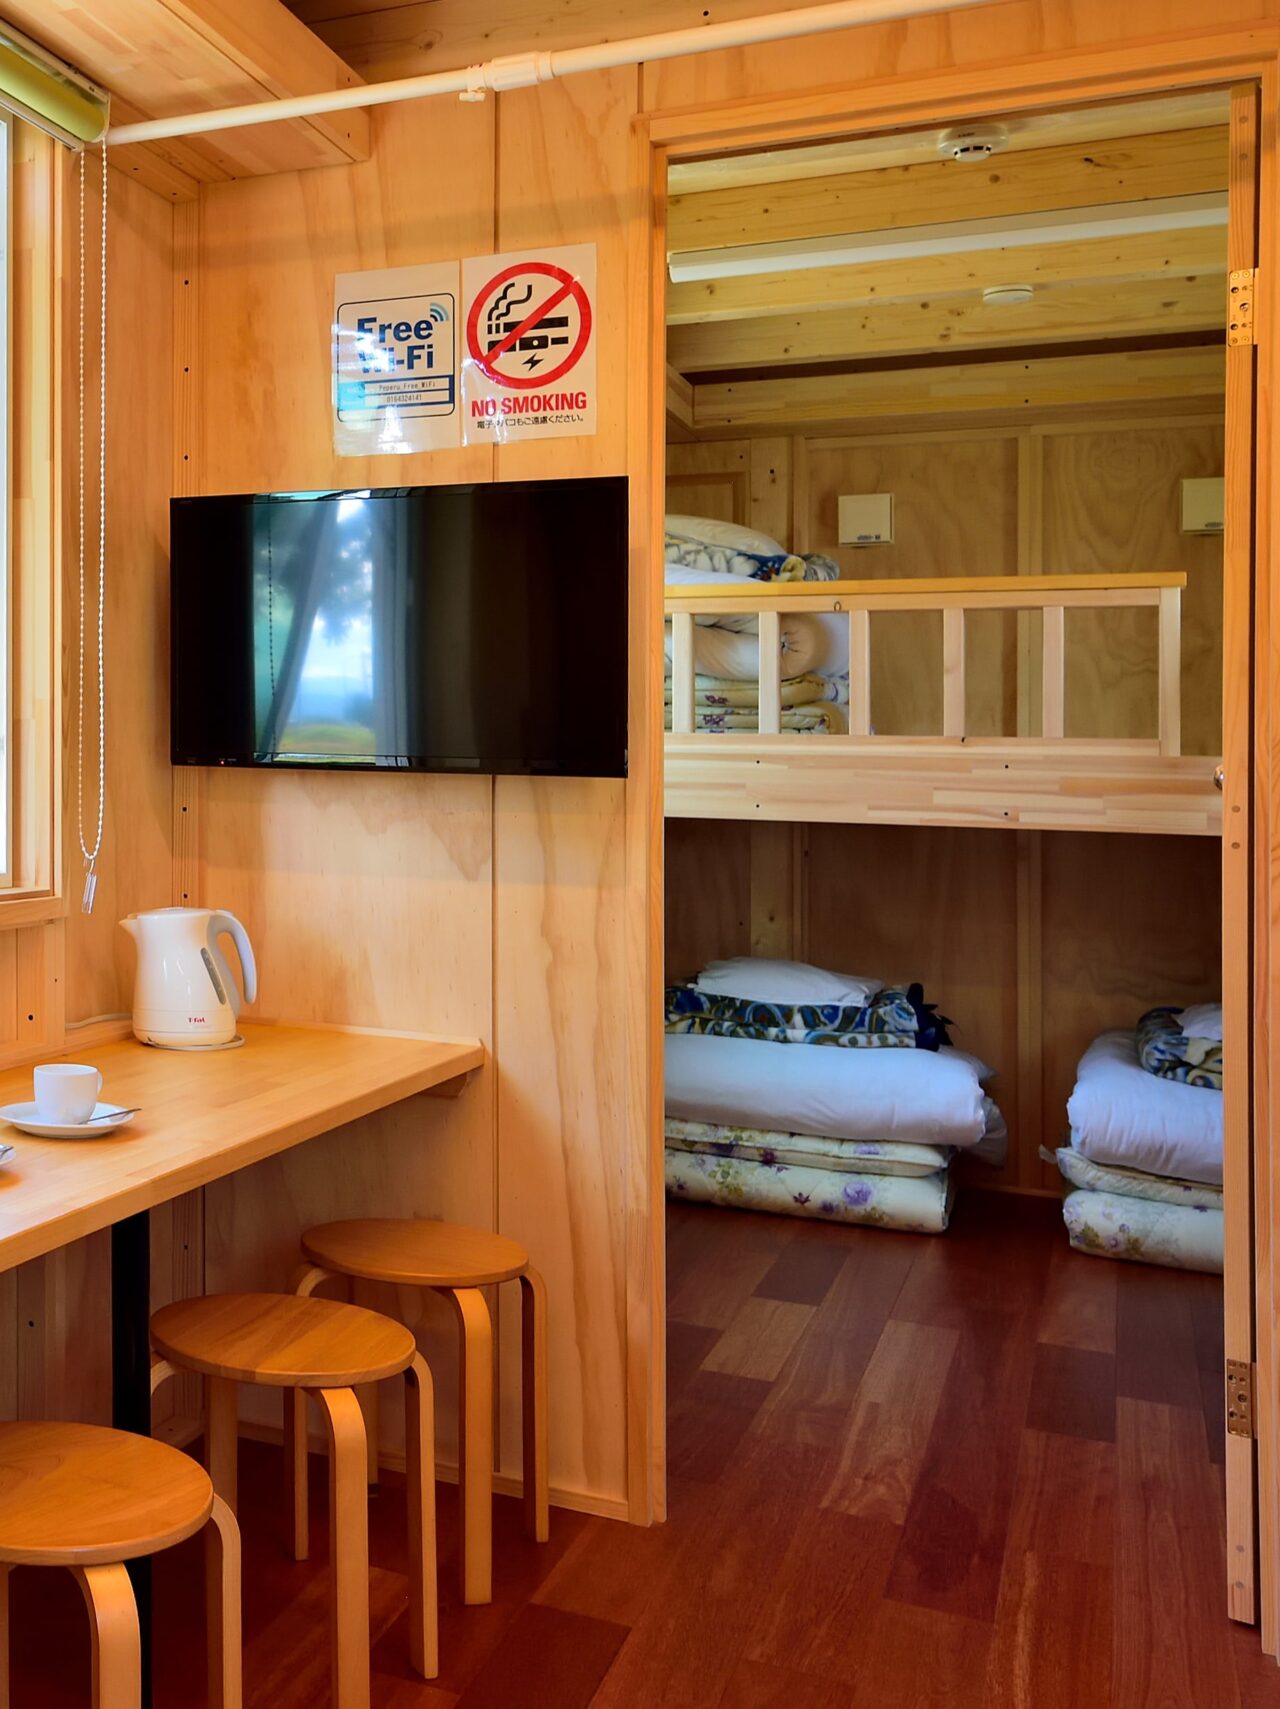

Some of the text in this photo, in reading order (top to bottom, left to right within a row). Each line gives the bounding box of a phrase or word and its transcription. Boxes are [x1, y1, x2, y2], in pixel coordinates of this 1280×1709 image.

[357, 317, 433, 343] Free
[471, 391, 587, 417] NO SMOKING
